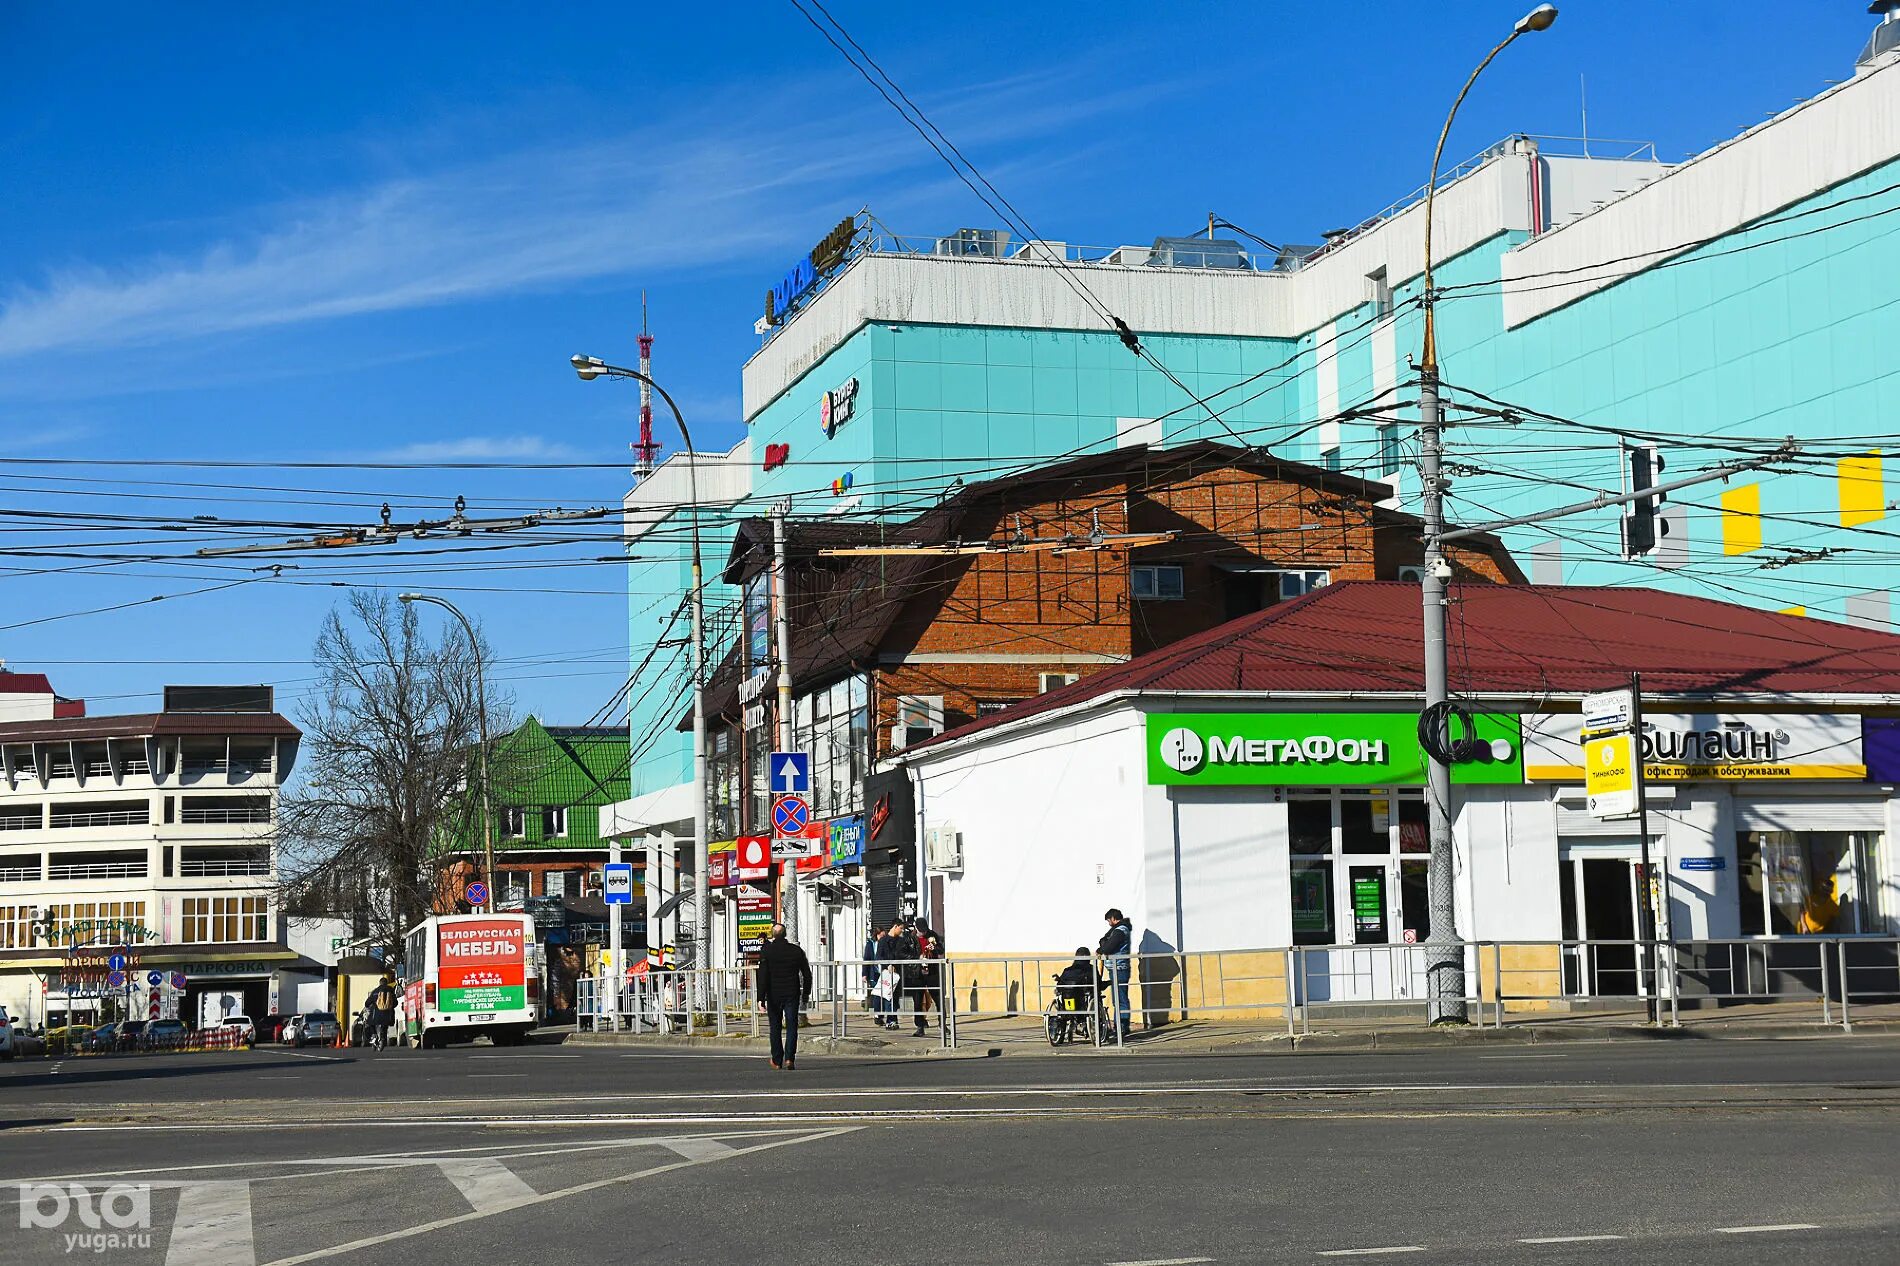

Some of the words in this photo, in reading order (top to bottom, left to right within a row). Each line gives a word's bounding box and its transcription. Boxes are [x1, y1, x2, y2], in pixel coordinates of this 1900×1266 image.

[773, 253, 815, 317] ROYAL
[1647, 766, 1671, 778] офис
[1674, 767, 1711, 778] продаж
[1721, 766, 1790, 778] обслуживания
[441, 928, 521, 940] БЕЛОРУССКАЯ
[525, 934, 534, 942] 101
[445, 941, 517, 957] МЕБЕЛЬ
[183, 961, 266, 974] ПАРКОВКА
[525, 957, 534, 966] 102
